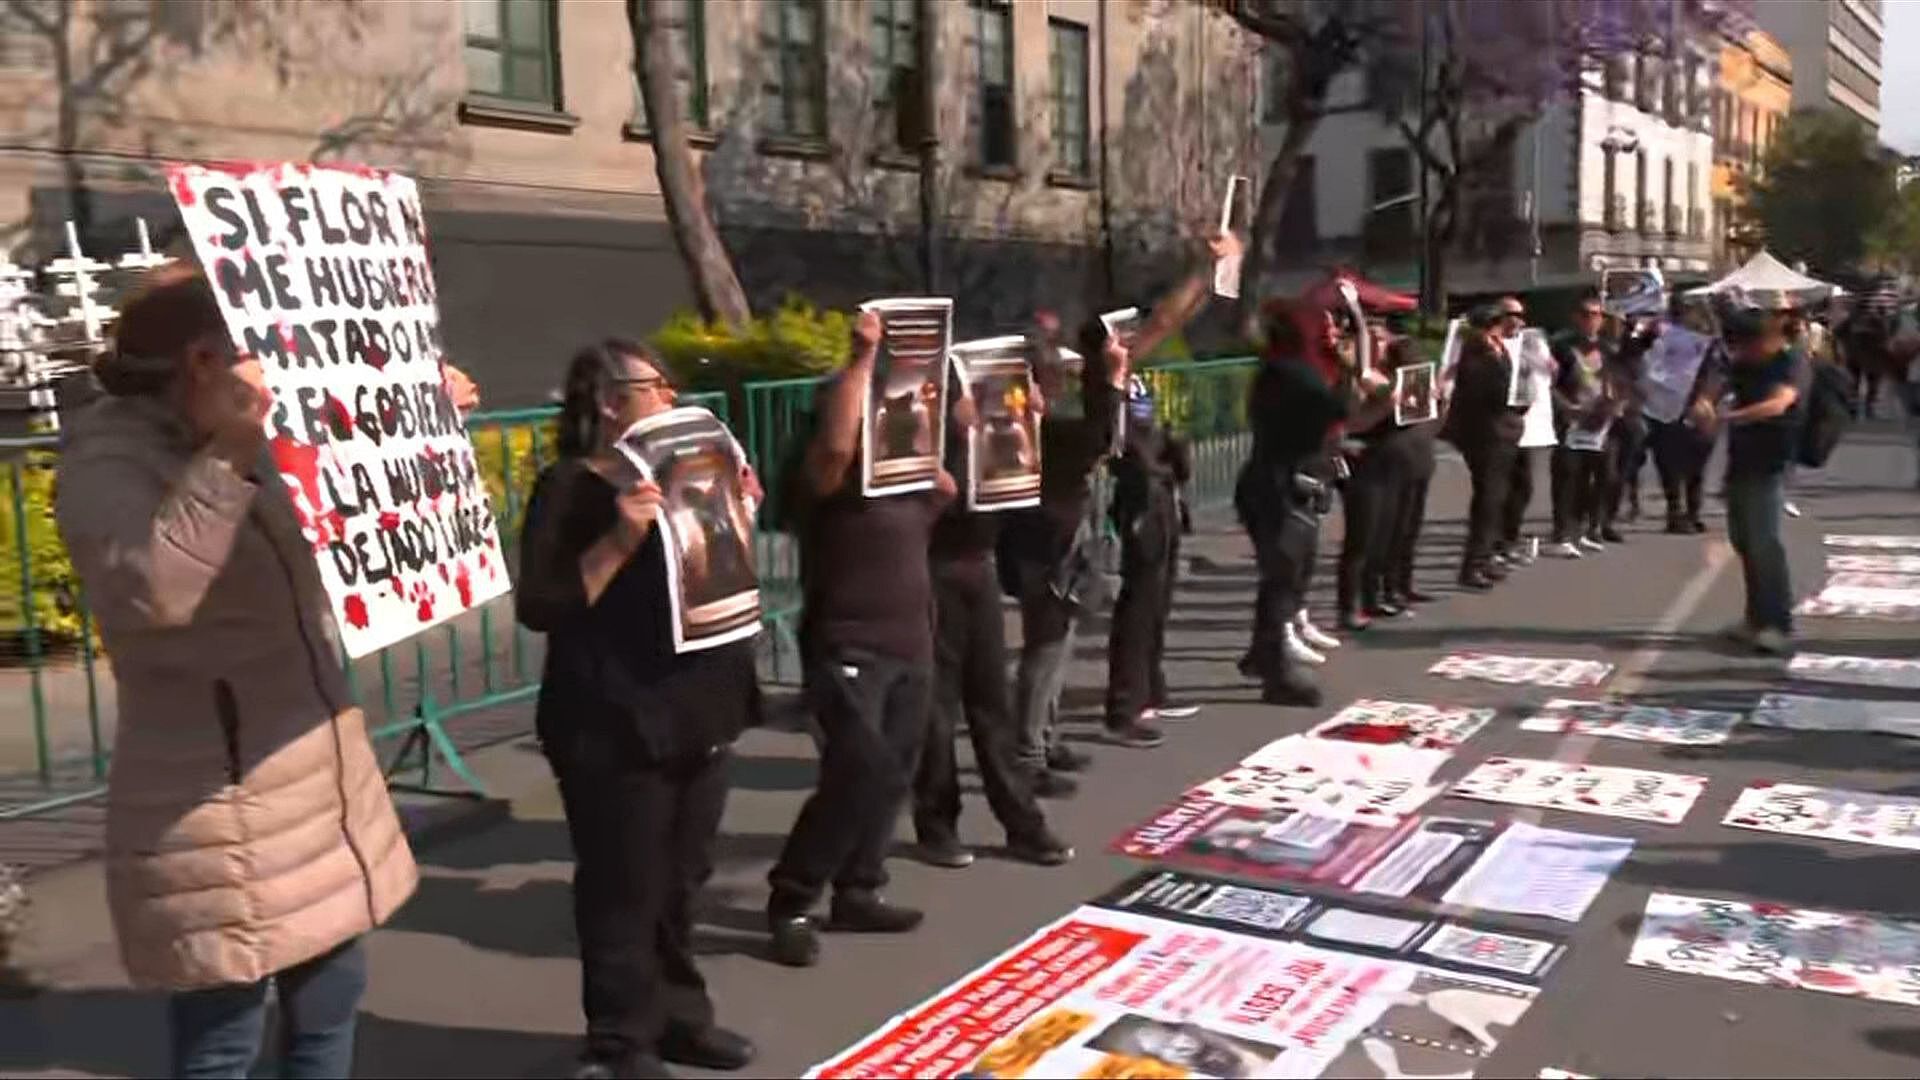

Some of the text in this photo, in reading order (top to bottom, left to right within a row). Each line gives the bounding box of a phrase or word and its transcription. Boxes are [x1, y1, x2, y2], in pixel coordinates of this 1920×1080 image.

[204, 187, 271, 250] SI
[279, 185, 398, 247] FLOR
[216, 252, 302, 310] ME
[243, 318, 411, 370] MATADO
[322, 463, 380, 517] LA
[329, 517, 437, 586] DEJADO
